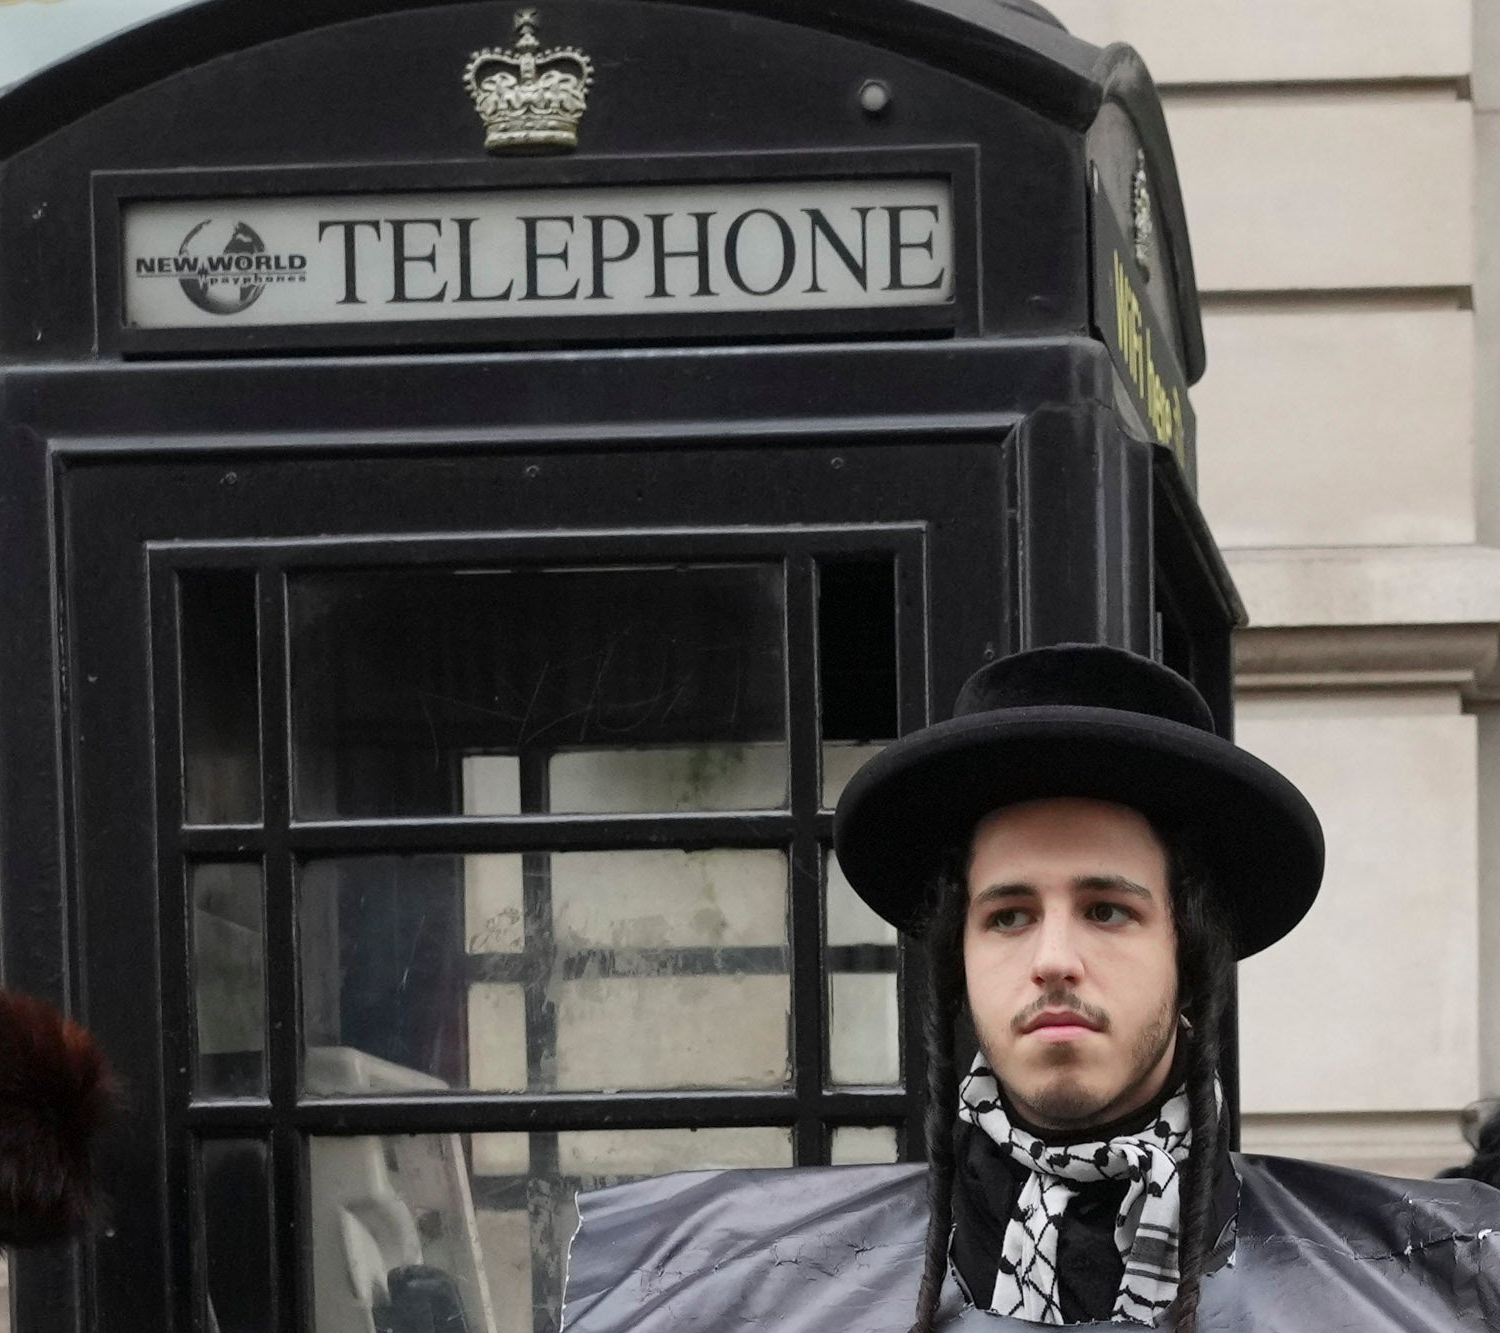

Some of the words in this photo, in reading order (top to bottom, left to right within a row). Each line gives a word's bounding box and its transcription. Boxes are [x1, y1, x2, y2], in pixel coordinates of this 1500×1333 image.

[136, 257, 199, 273] NEW
[207, 254, 307, 271] WORLD
[317, 204, 945, 304] TELEPHONE
[209, 273, 307, 286] payphones
